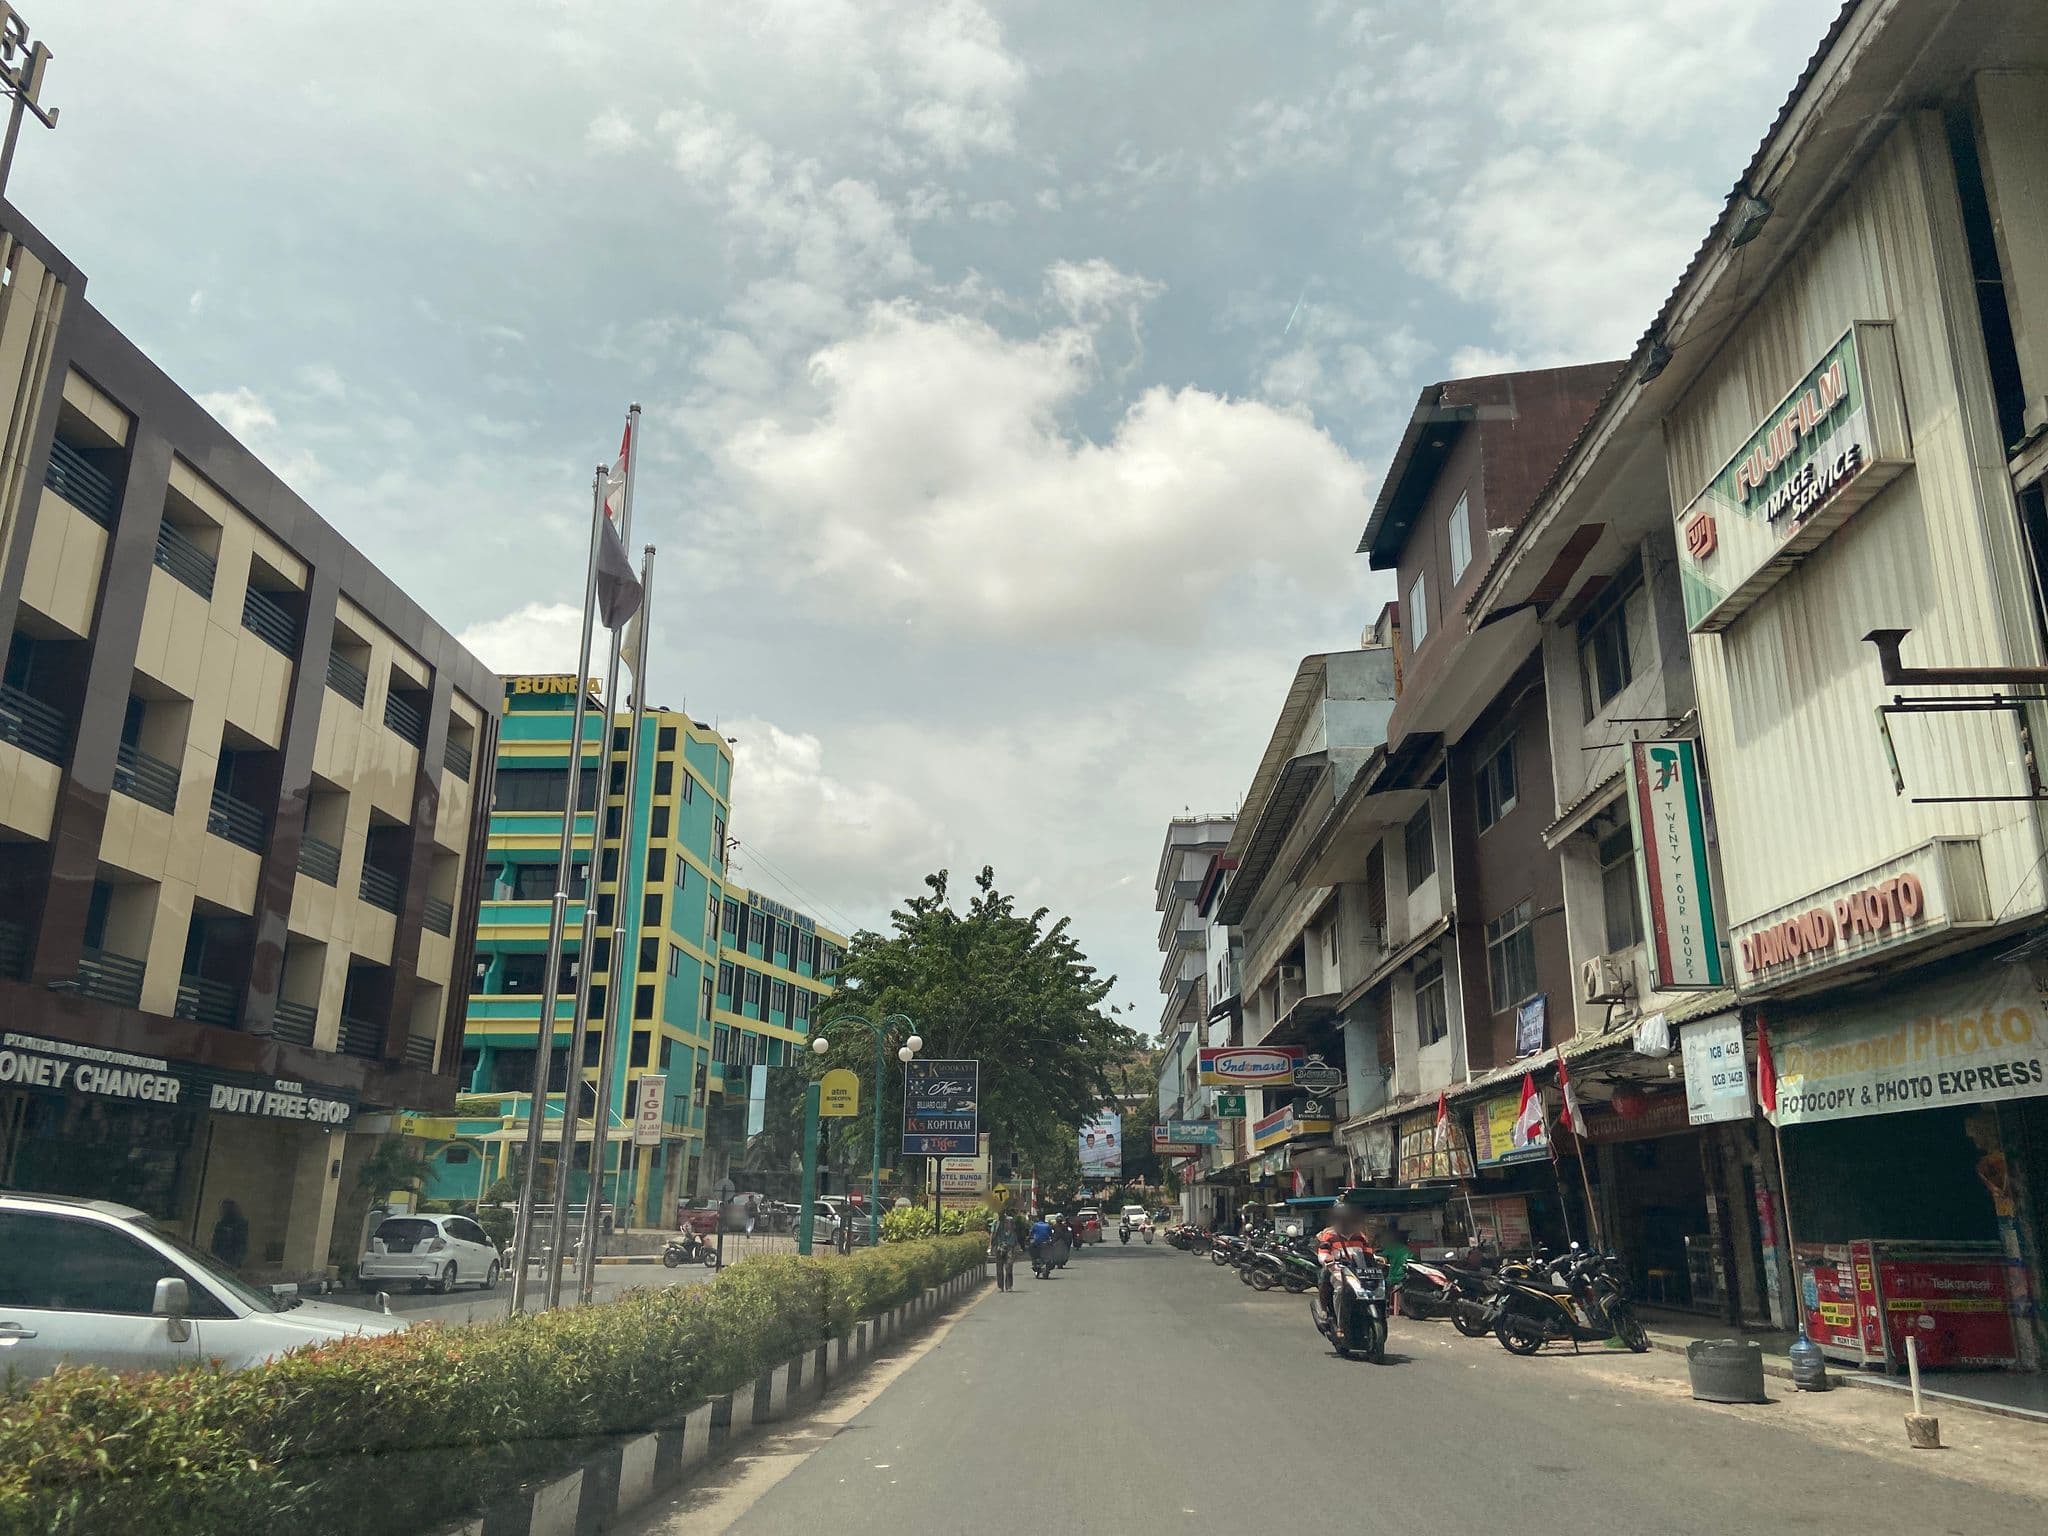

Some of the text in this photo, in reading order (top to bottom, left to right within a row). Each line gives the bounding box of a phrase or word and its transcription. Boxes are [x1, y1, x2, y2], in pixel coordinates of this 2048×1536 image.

[1734, 360, 1847, 504] FUJIFILM
[1765, 463, 1814, 522] IMAGE
[1792, 444, 1861, 520] SERVICE
[1664, 801, 1694, 979] TWENTY FOUR HOURS
[1740, 872, 1924, 973] DIAMOND PHOTO
[1709, 1042, 1740, 1059] 1GB 4GB
[1913, 1004, 2034, 1062] Photo
[0, 1051, 180, 1103] ONEY CHANGER
[1220, 1059, 1286, 1073] Indomaret
[1711, 1073, 1726, 1086] 12GB
[1782, 1059, 2043, 1116] FOTOCOPY & PHOTO EXPRESS
[210, 1084, 265, 1114] DUTY
[262, 1092, 308, 1119] FREE
[307, 1098, 350, 1123] SHOP
[927, 1119, 971, 1130] KOPITIAM
[931, 1136, 958, 1152] Tiger
